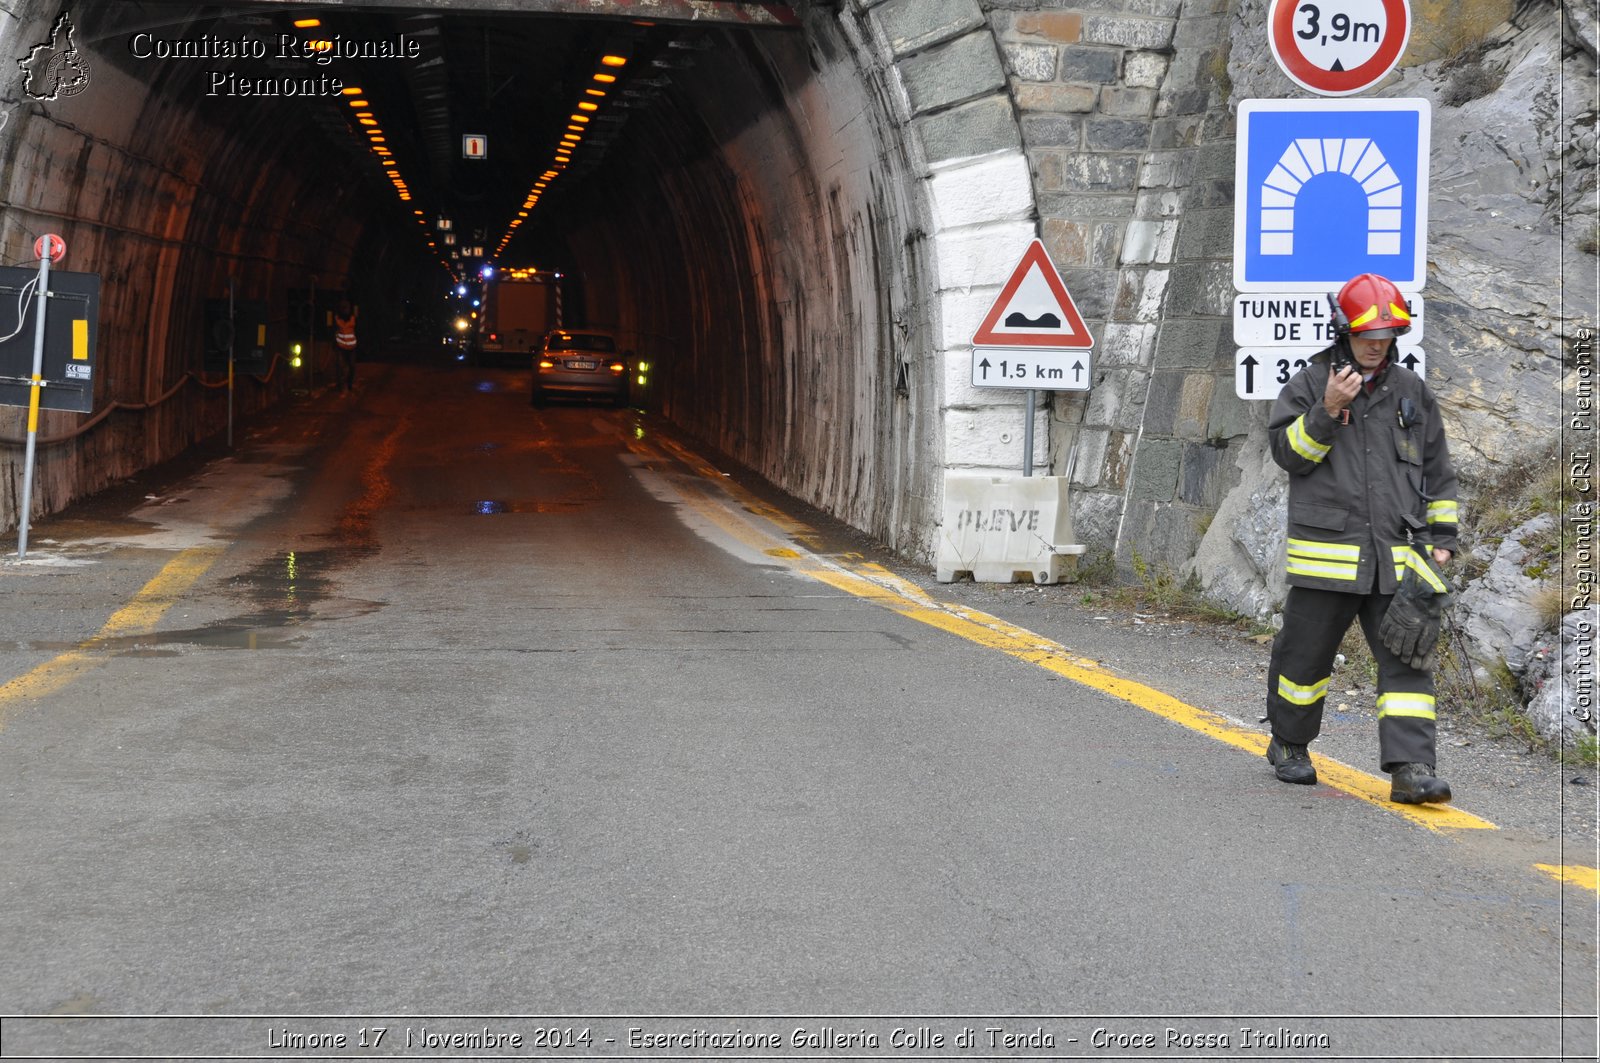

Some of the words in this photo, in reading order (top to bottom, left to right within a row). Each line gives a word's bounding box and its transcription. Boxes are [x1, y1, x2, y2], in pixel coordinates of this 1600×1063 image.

[1297, 4, 1380, 46] 3,9m
[1239, 300, 1324, 318] TUNNEL
[1274, 323, 1301, 341] DE
[1036, 365, 1063, 379] km
